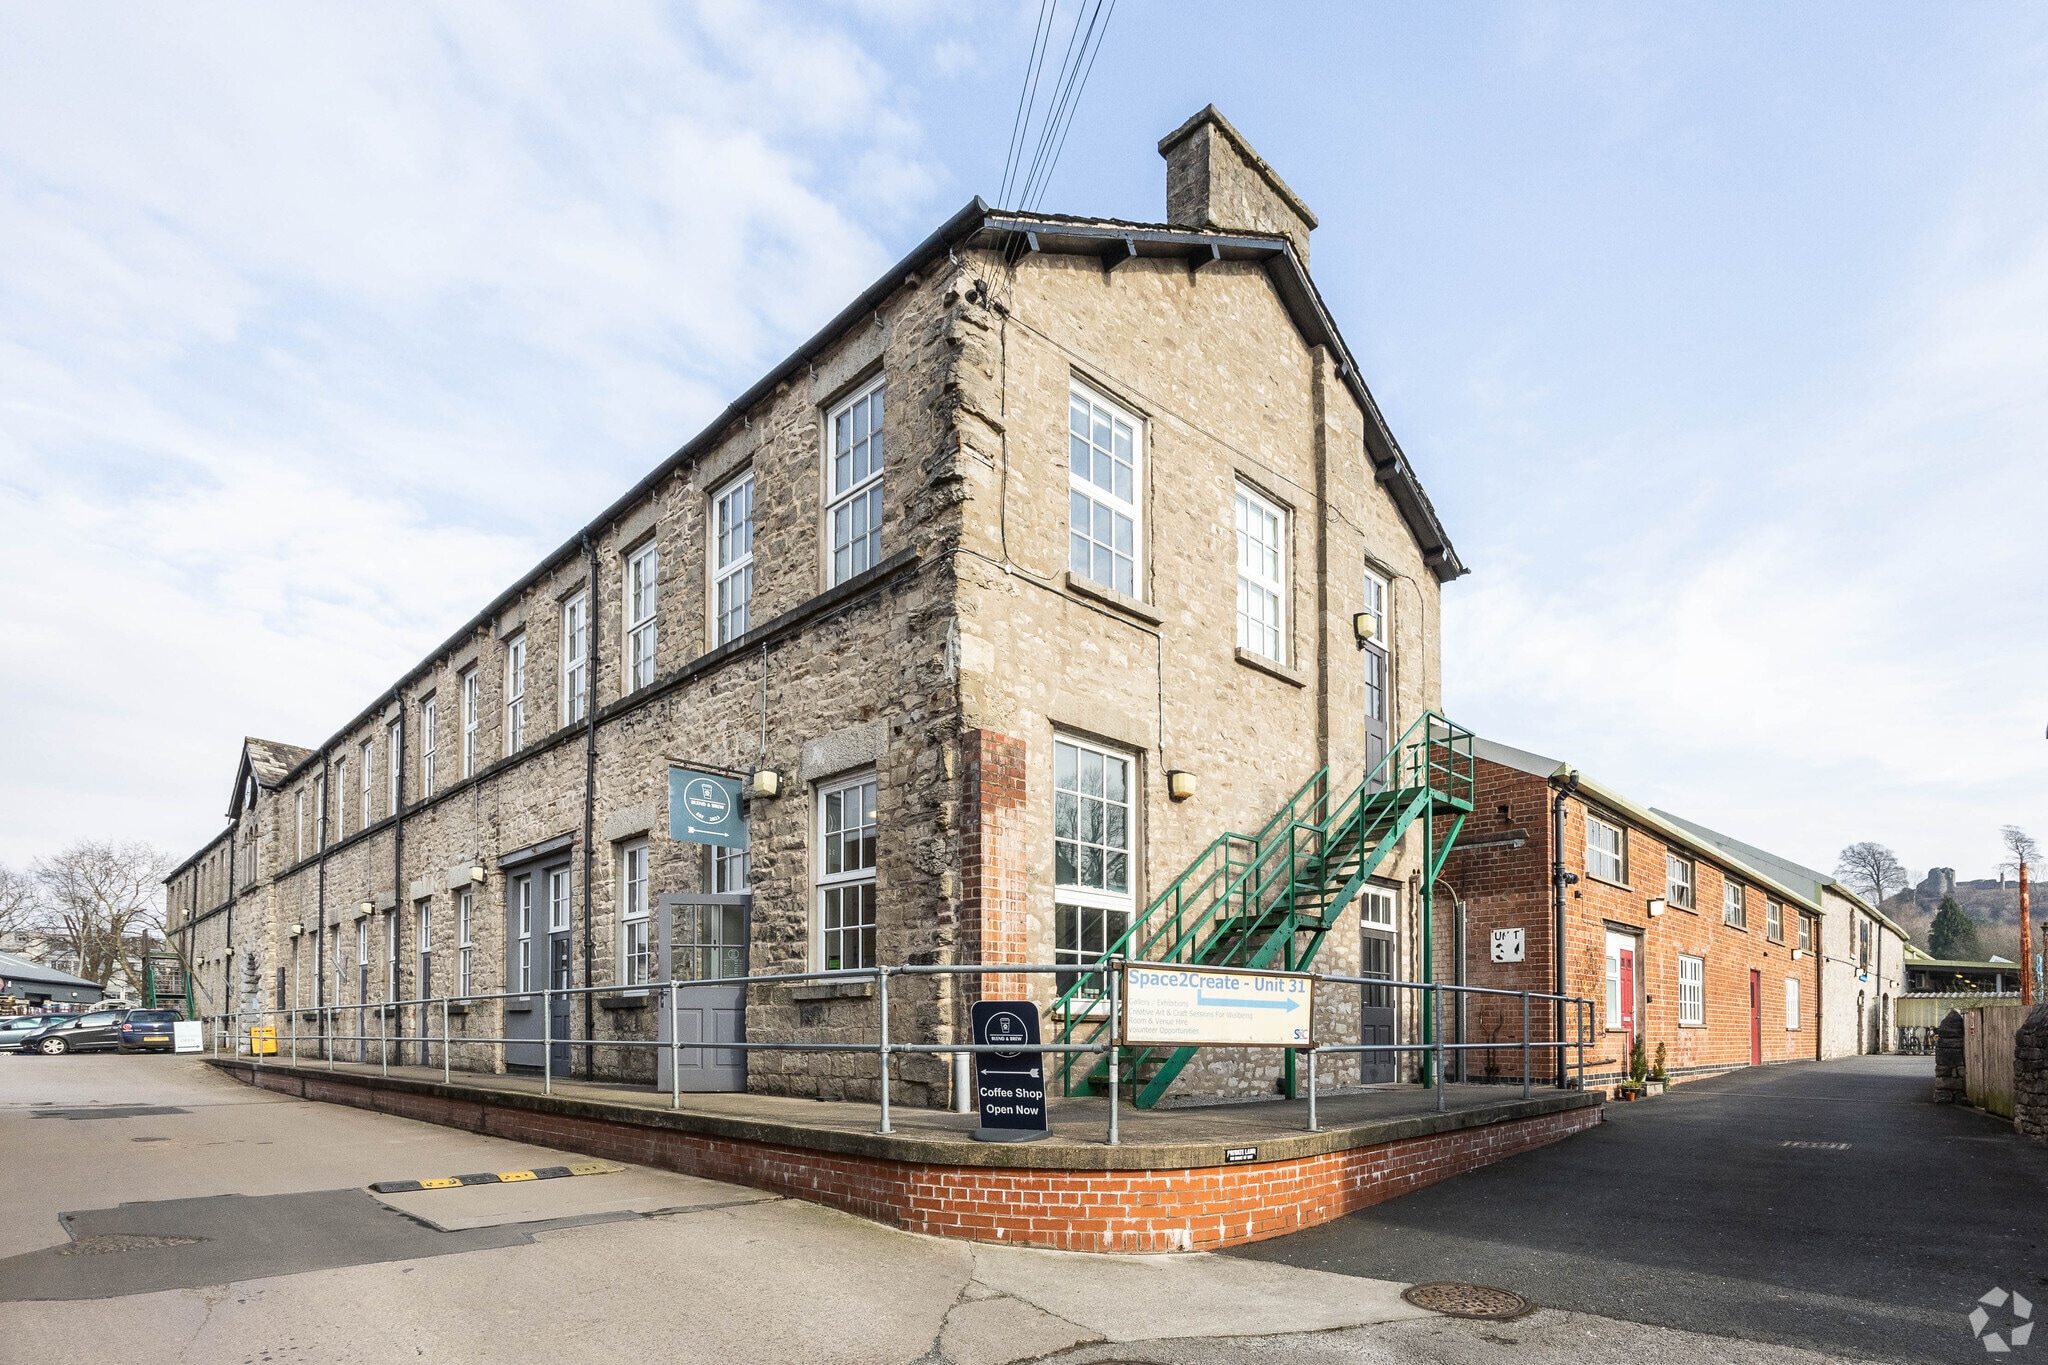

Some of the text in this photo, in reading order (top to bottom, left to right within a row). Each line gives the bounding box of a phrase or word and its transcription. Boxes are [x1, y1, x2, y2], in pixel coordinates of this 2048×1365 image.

[1129, 969, 1239, 990] Space2Create
[1254, 977, 1284, 992] Unit
[1288, 979, 1305, 993] 31
[1157, 999, 1189, 1007] Exhibitions
[1129, 1017, 1146, 1025] Room
[1159, 1026, 1199, 1035] Opportunities
[980, 1087, 1043, 1100] Coffee Shop
[986, 1104, 1039, 1116] Open Now
